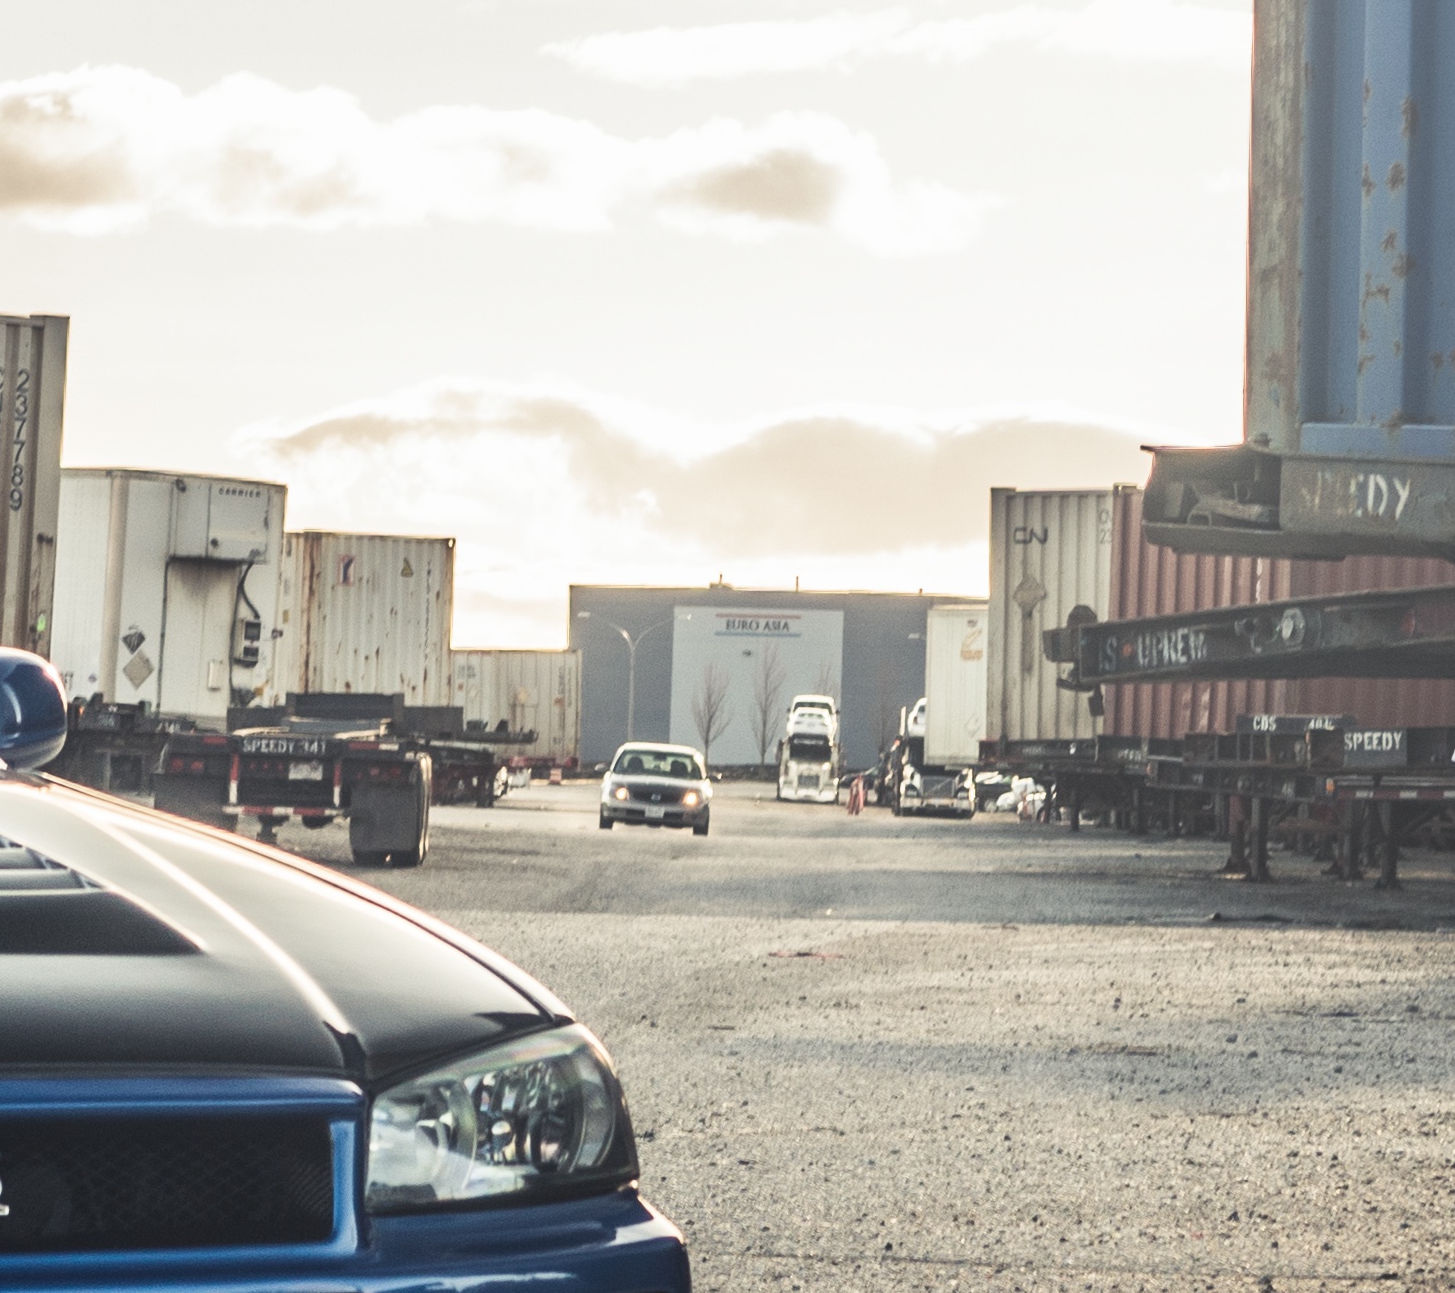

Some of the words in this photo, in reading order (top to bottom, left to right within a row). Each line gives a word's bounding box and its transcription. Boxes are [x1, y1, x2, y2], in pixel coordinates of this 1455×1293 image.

[9, 368, 31, 512] 237789
[1013, 527, 1049, 545] CN
[725, 618, 760, 631] EURO
[762, 619, 790, 632] ASIA
[242, 738, 295, 753] SPEEDY
[1344, 731, 1402, 752] SPEEDY
